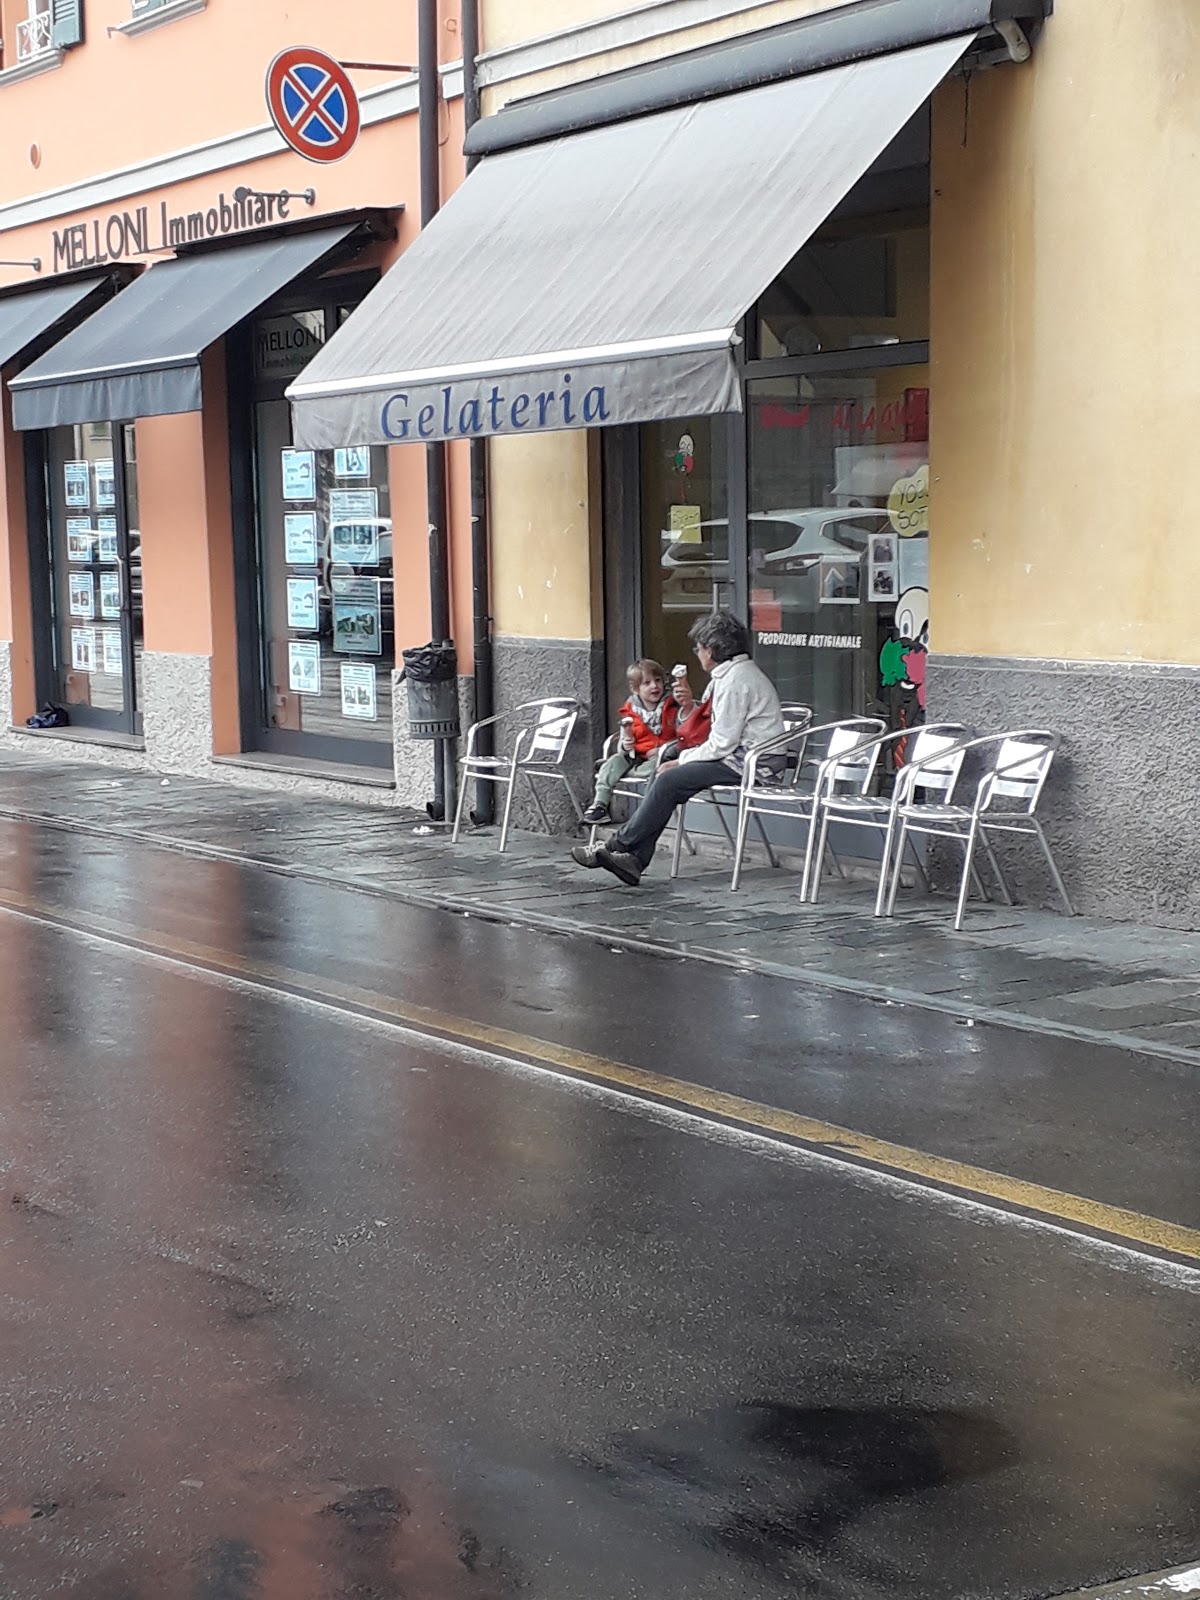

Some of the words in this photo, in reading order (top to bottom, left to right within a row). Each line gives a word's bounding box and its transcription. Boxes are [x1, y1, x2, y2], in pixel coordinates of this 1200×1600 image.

[52, 206, 150, 273] MELLONI
[160, 189, 290, 248] Immobiliare
[380, 372, 611, 439] Gelateria
[757, 631, 807, 646] PRODUZIONE
[808, 634, 862, 648] ARTIGIANALE
